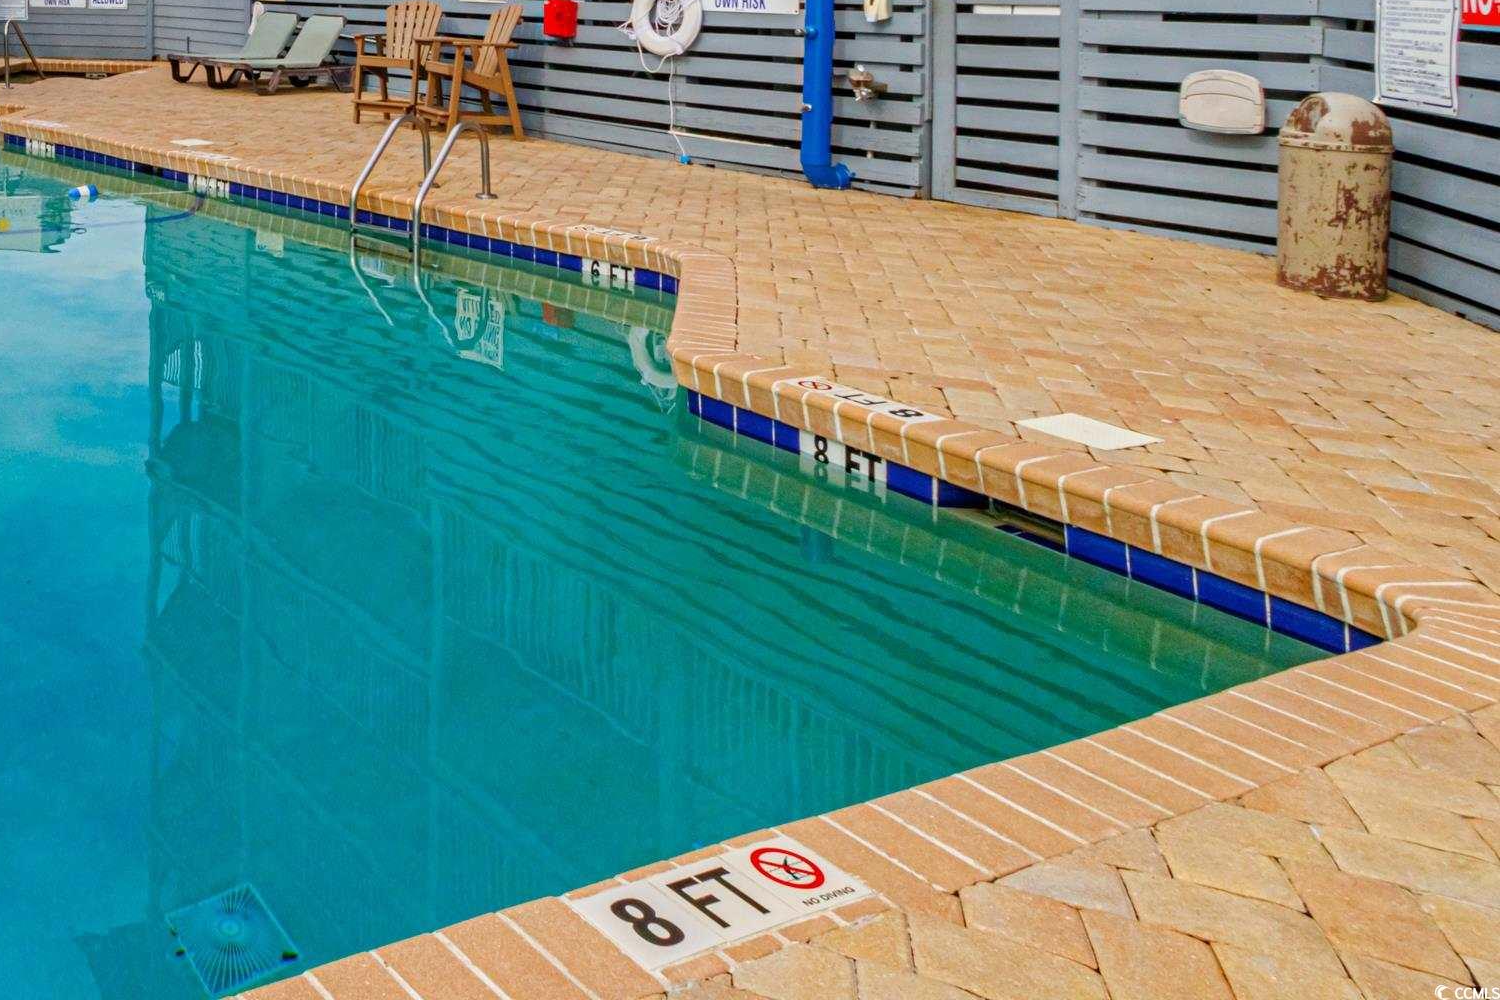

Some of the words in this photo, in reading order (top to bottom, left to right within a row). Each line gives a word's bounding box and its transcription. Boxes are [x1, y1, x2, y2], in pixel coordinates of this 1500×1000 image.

[591, 260, 600, 277] 6
[610, 263, 634, 283] FT
[814, 434, 829, 464] 8
[845, 444, 884, 483] FT
[610, 897, 685, 946] 8
[666, 866, 771, 929] FT
[802, 897, 820, 907] NO
[820, 886, 856, 901] DIVING
